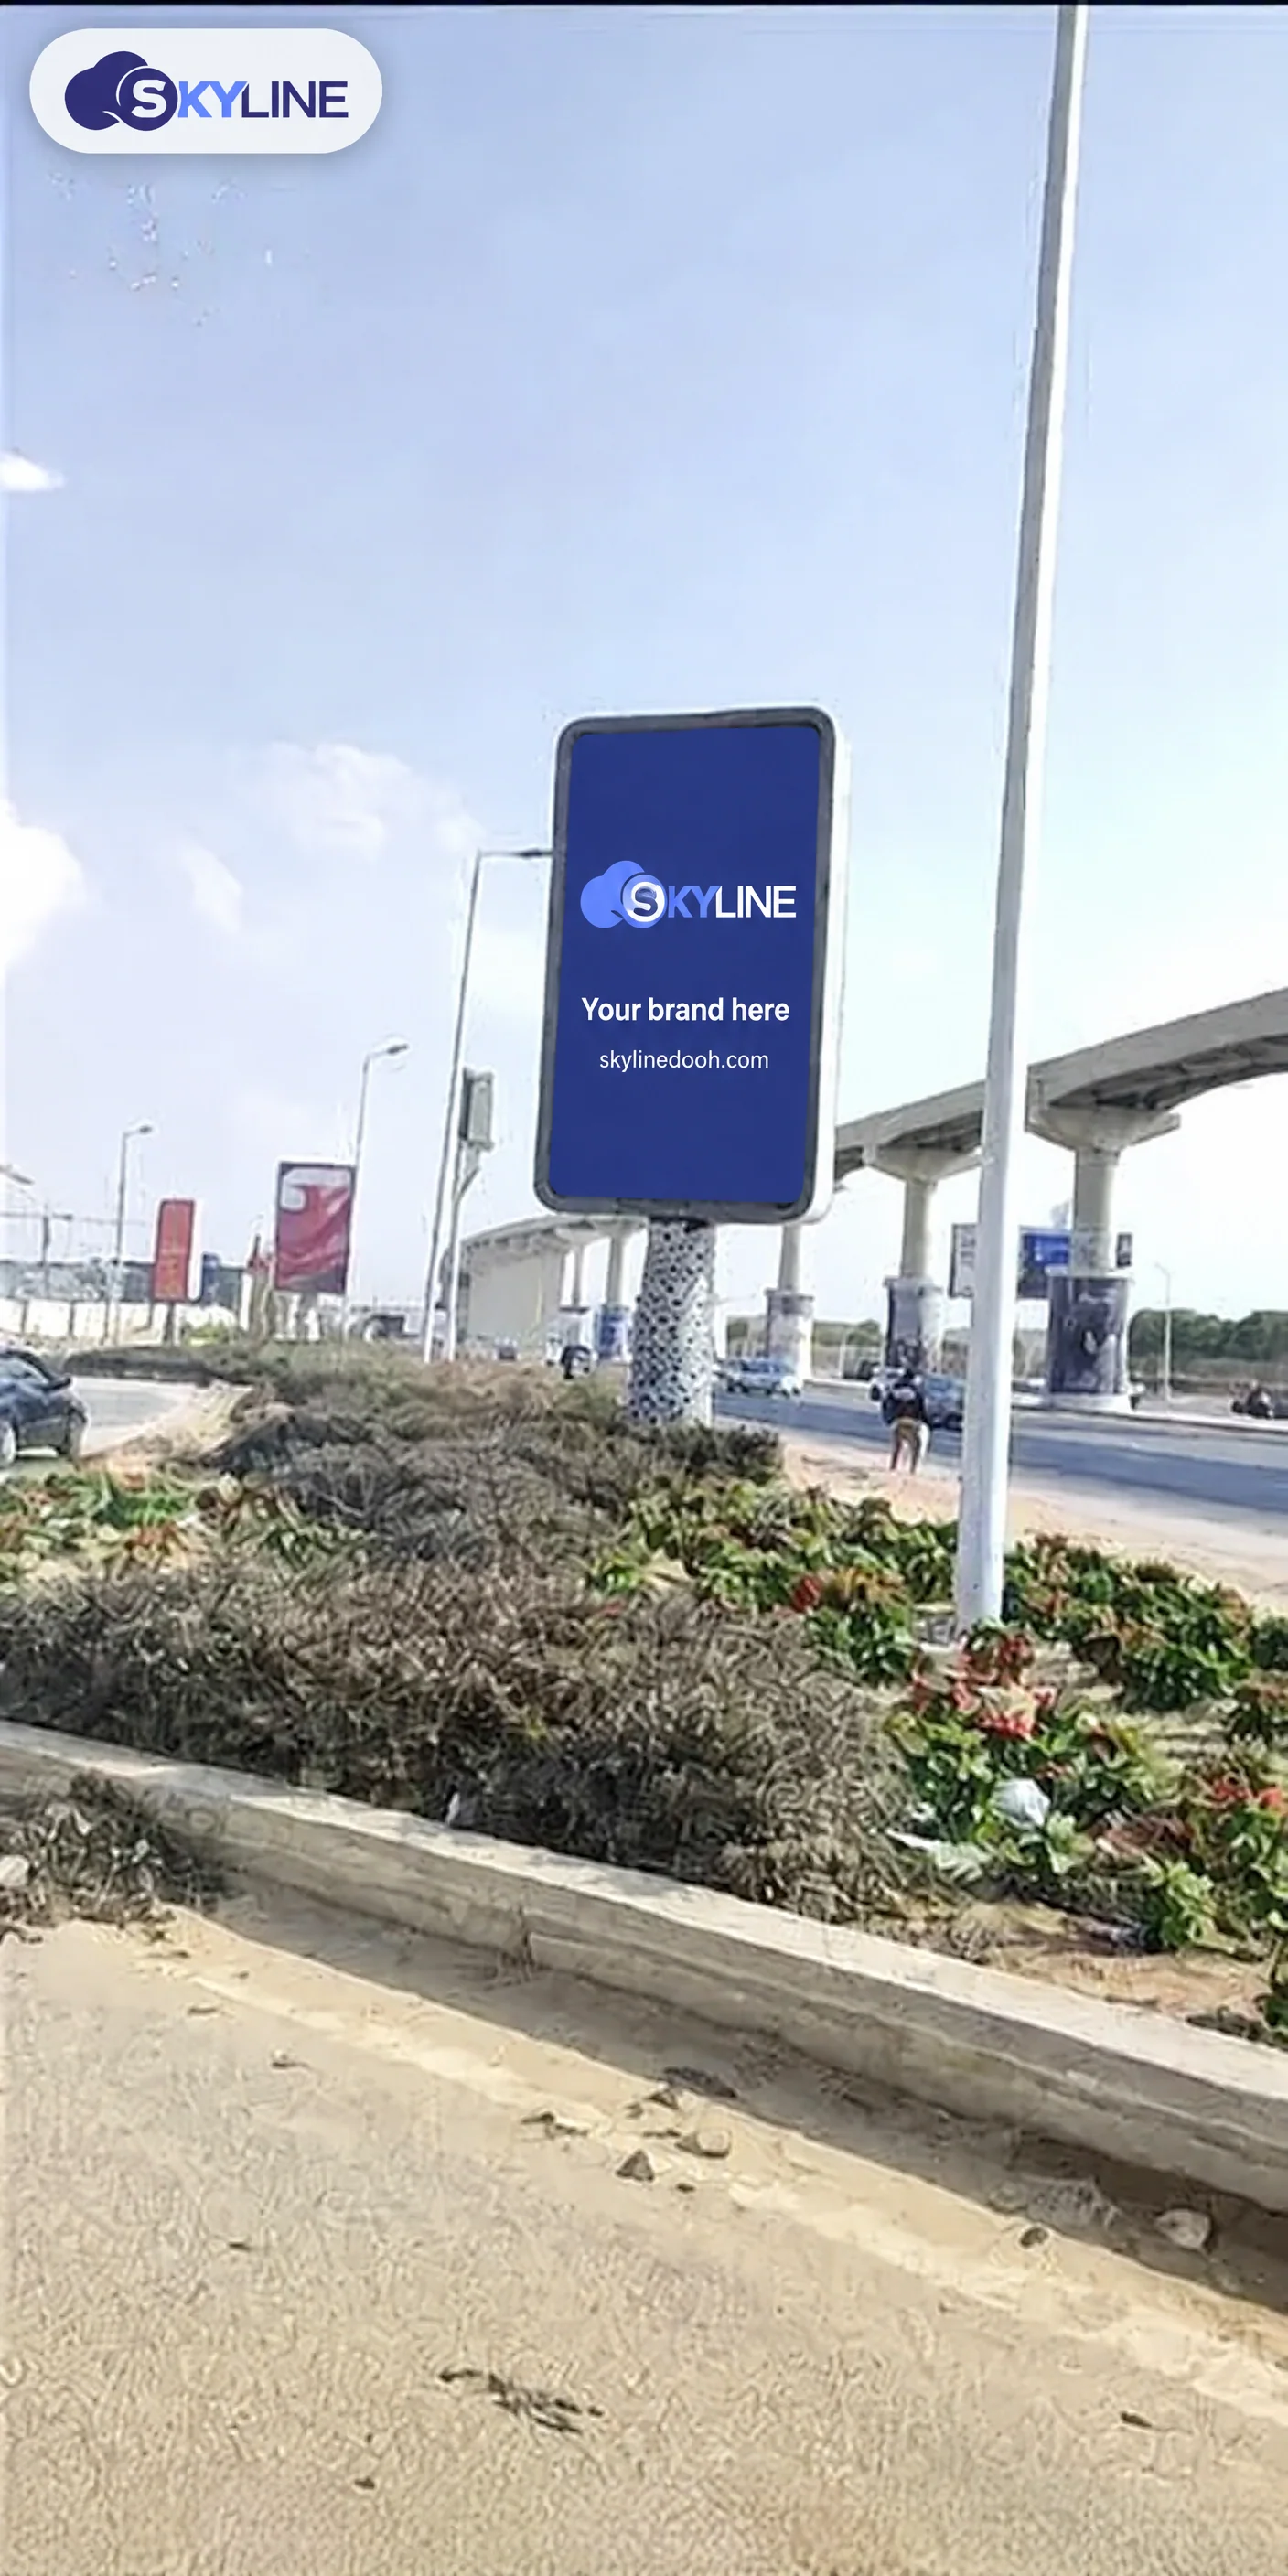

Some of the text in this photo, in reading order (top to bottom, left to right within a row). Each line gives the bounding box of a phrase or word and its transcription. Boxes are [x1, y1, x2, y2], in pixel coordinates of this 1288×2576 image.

[632, 885, 797, 918] SKYLINE
[581, 997, 790, 1021] Your brand here
[599, 1049, 769, 1072] skylinedooh.com
